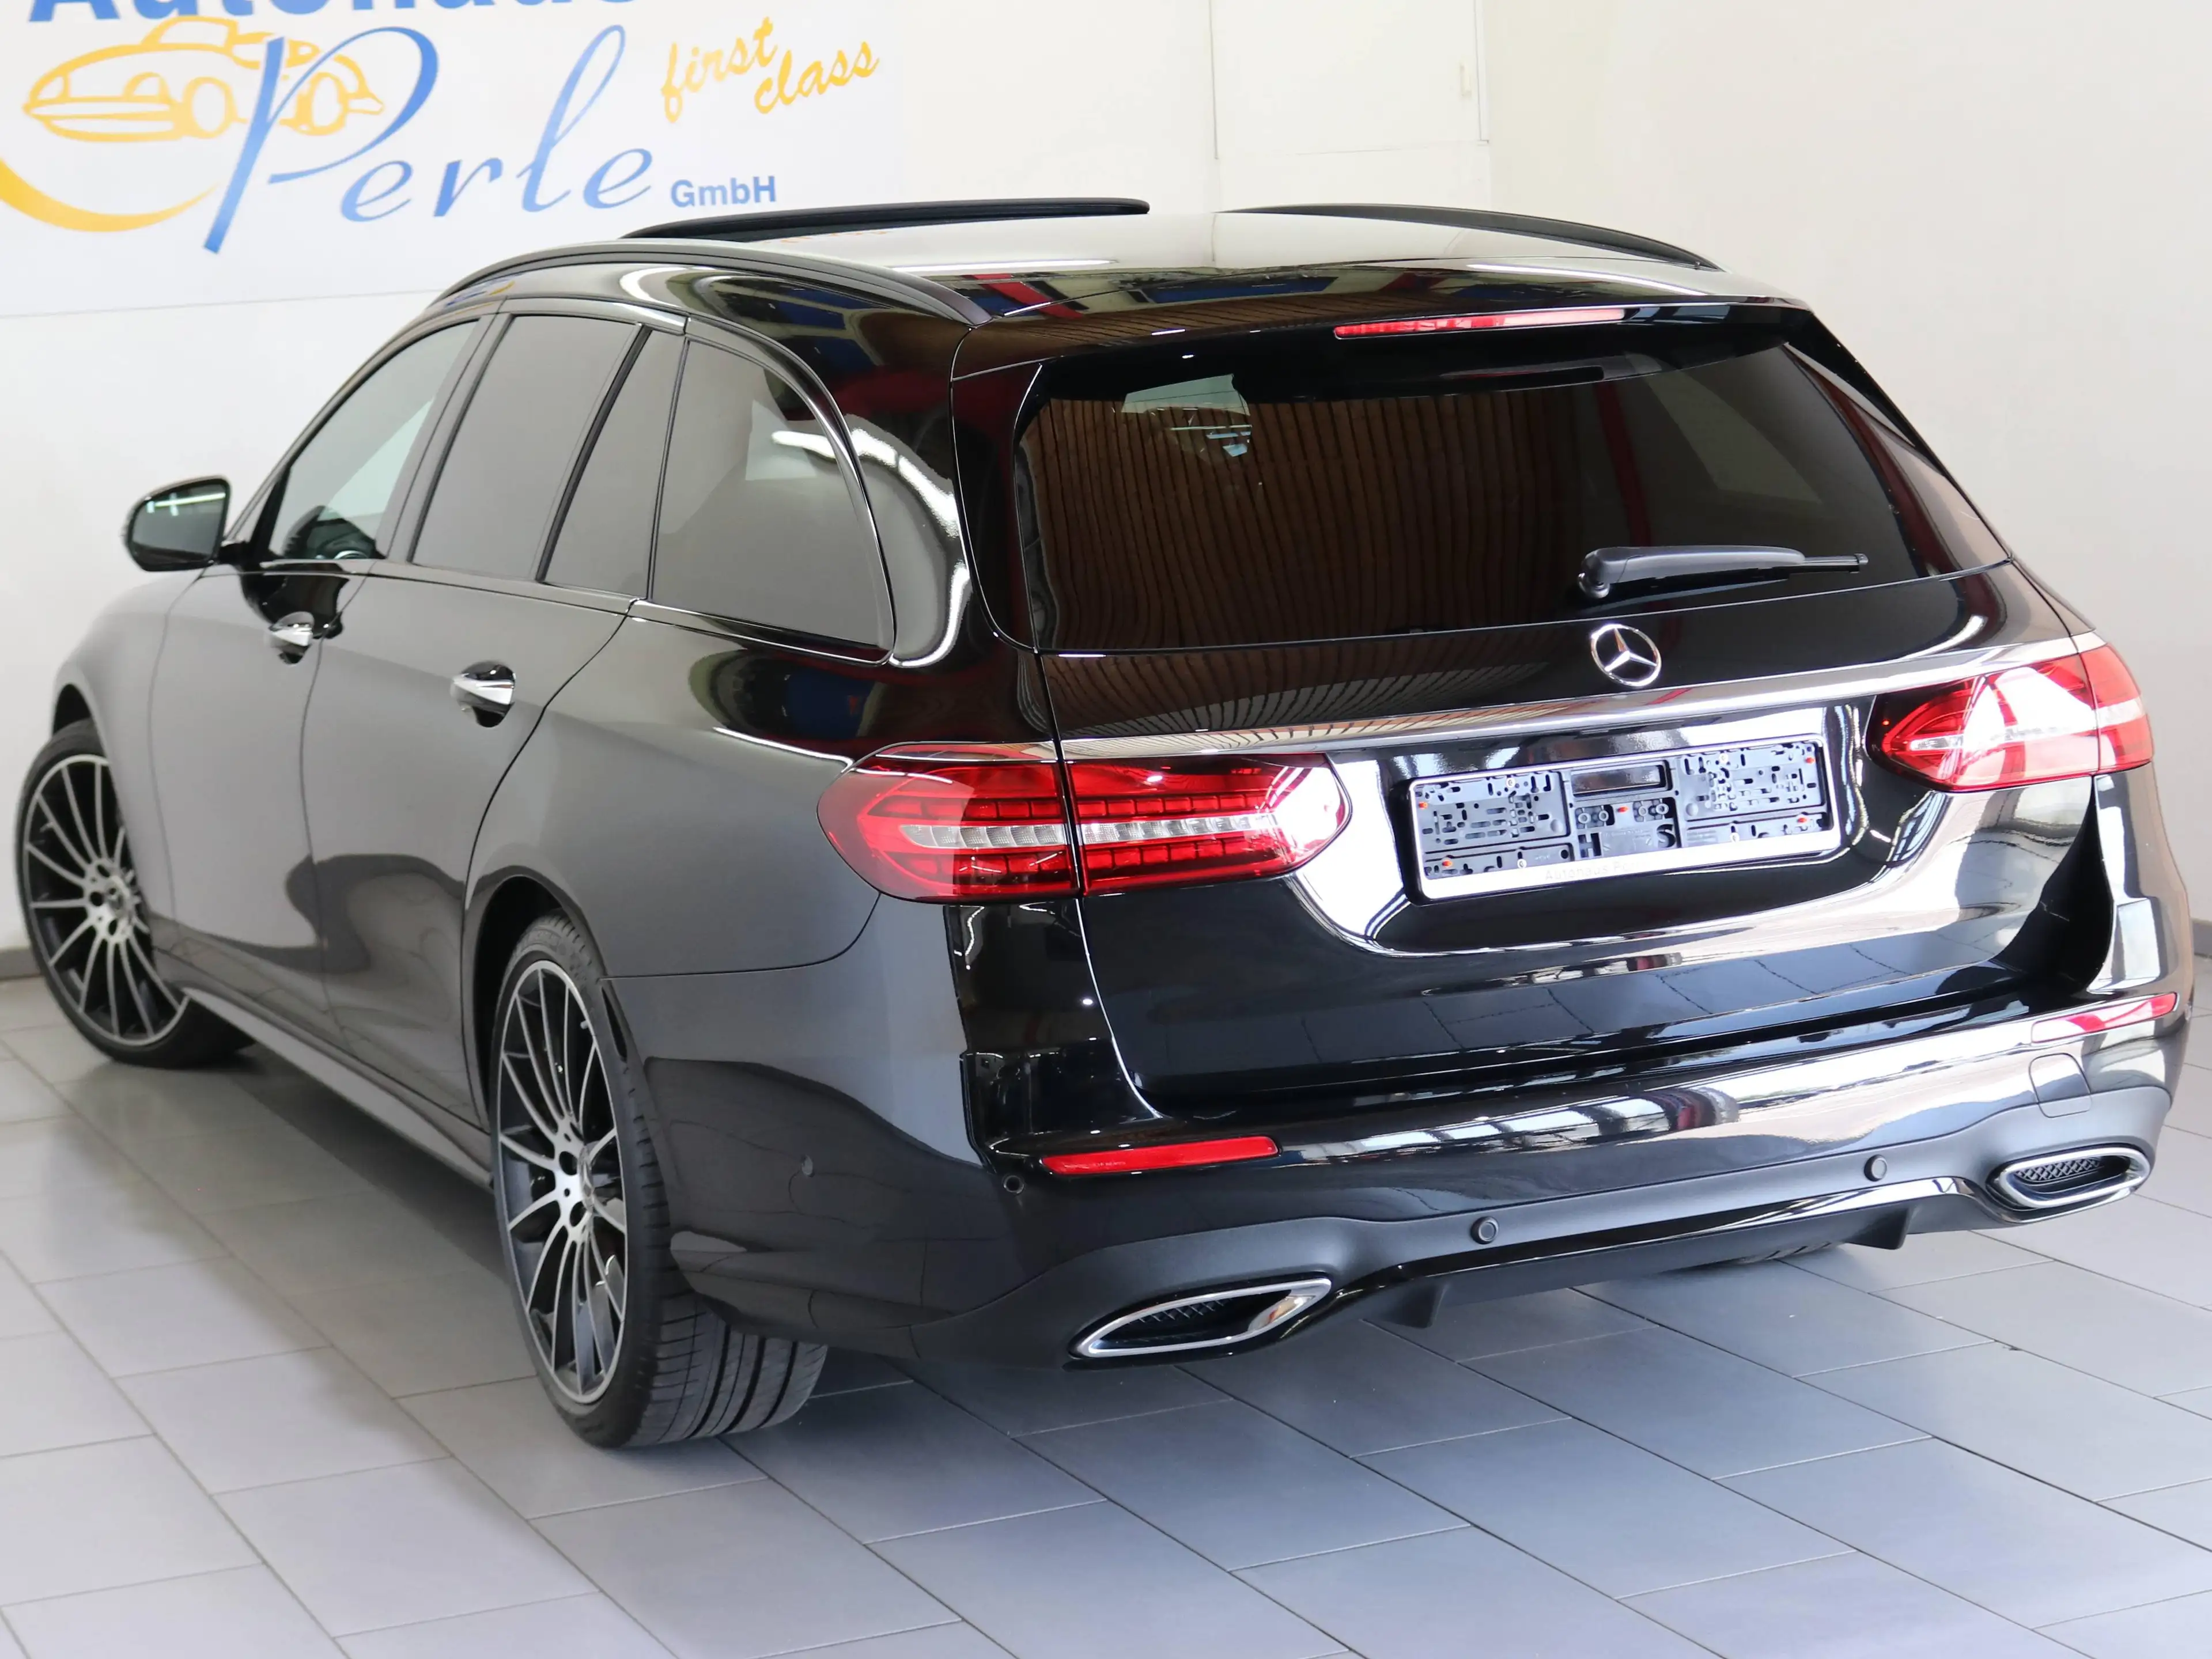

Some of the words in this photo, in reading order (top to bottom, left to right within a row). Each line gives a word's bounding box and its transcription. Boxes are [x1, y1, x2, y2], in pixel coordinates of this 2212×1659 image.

[203, 25, 652, 254] Perle
[671, 175, 776, 208] GmbH
[661, 16, 778, 123] first
[754, 41, 880, 114] class
